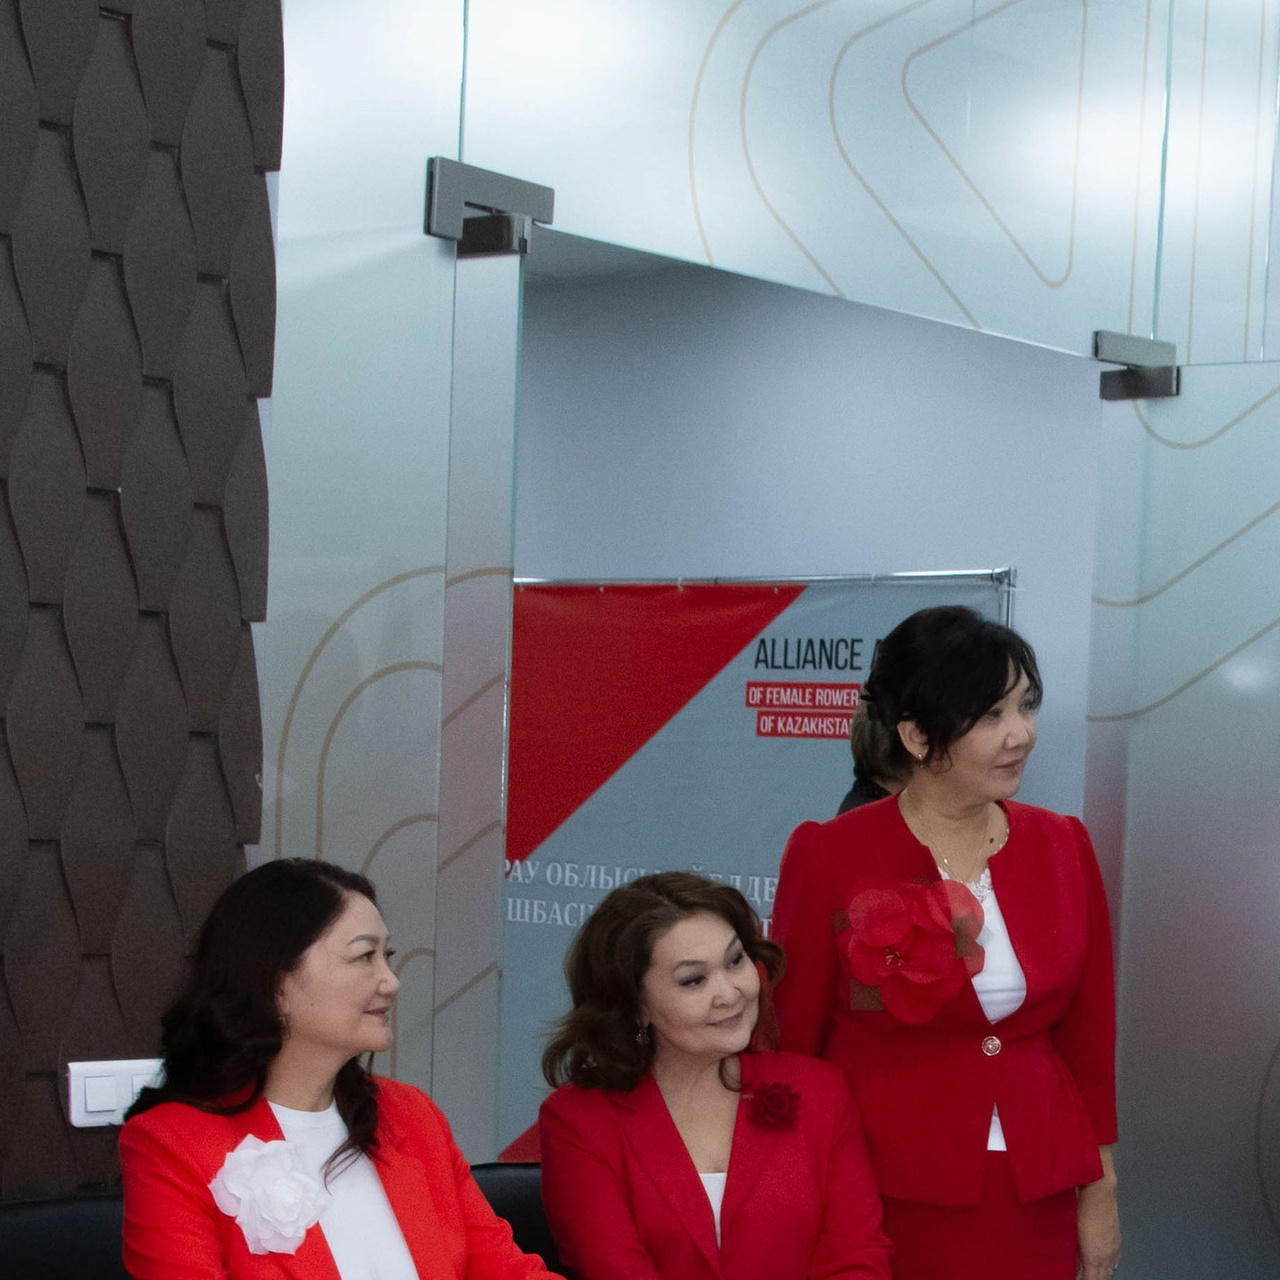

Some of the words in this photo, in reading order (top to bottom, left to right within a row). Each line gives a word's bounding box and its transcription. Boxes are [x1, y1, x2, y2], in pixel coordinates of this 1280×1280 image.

[754, 637, 864, 671] ALLIANCE
[749, 687, 764, 705] OF
[766, 688, 814, 706] FEMALE
[760, 715, 777, 733] OF
[546, 861, 662, 890] ОБЛЫС
